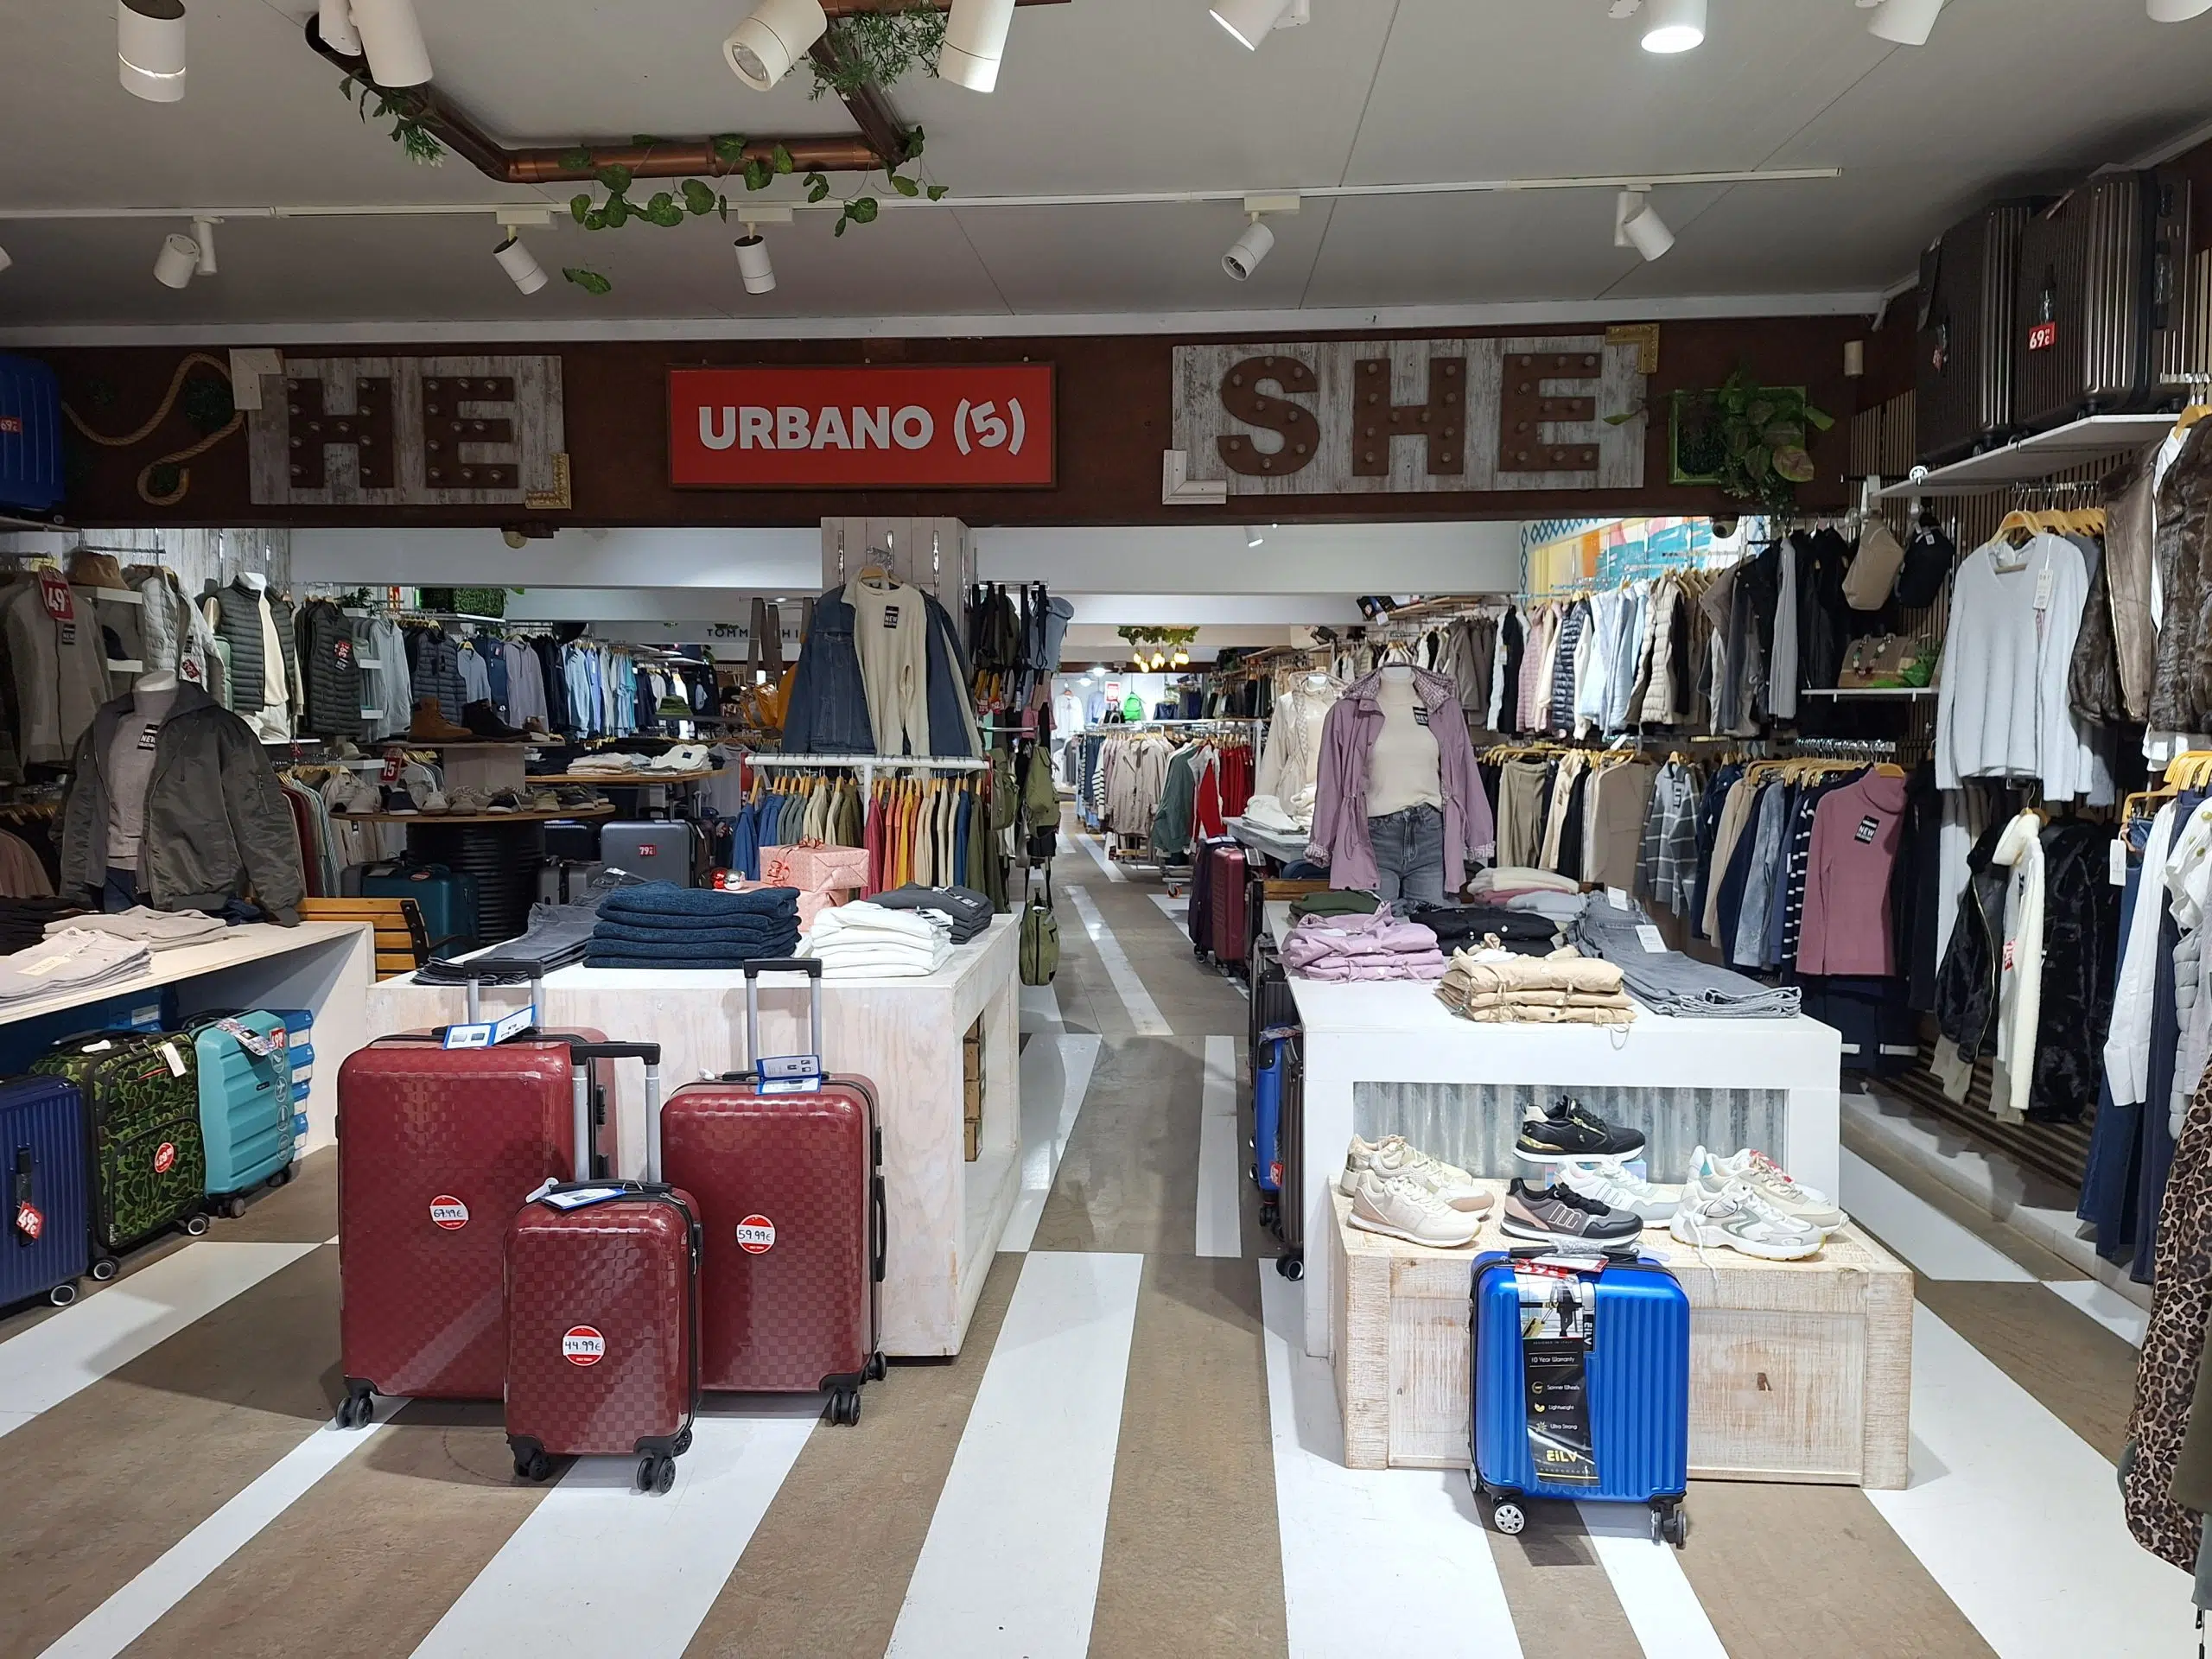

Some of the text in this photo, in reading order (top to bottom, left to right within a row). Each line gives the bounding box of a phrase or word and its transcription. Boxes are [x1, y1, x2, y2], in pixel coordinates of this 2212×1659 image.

[287, 377, 518, 487] HE
[699, 397, 1026, 455] URBANO (5)
[1217, 353, 1602, 476] SHE
[707, 629, 748, 638] TOMM
